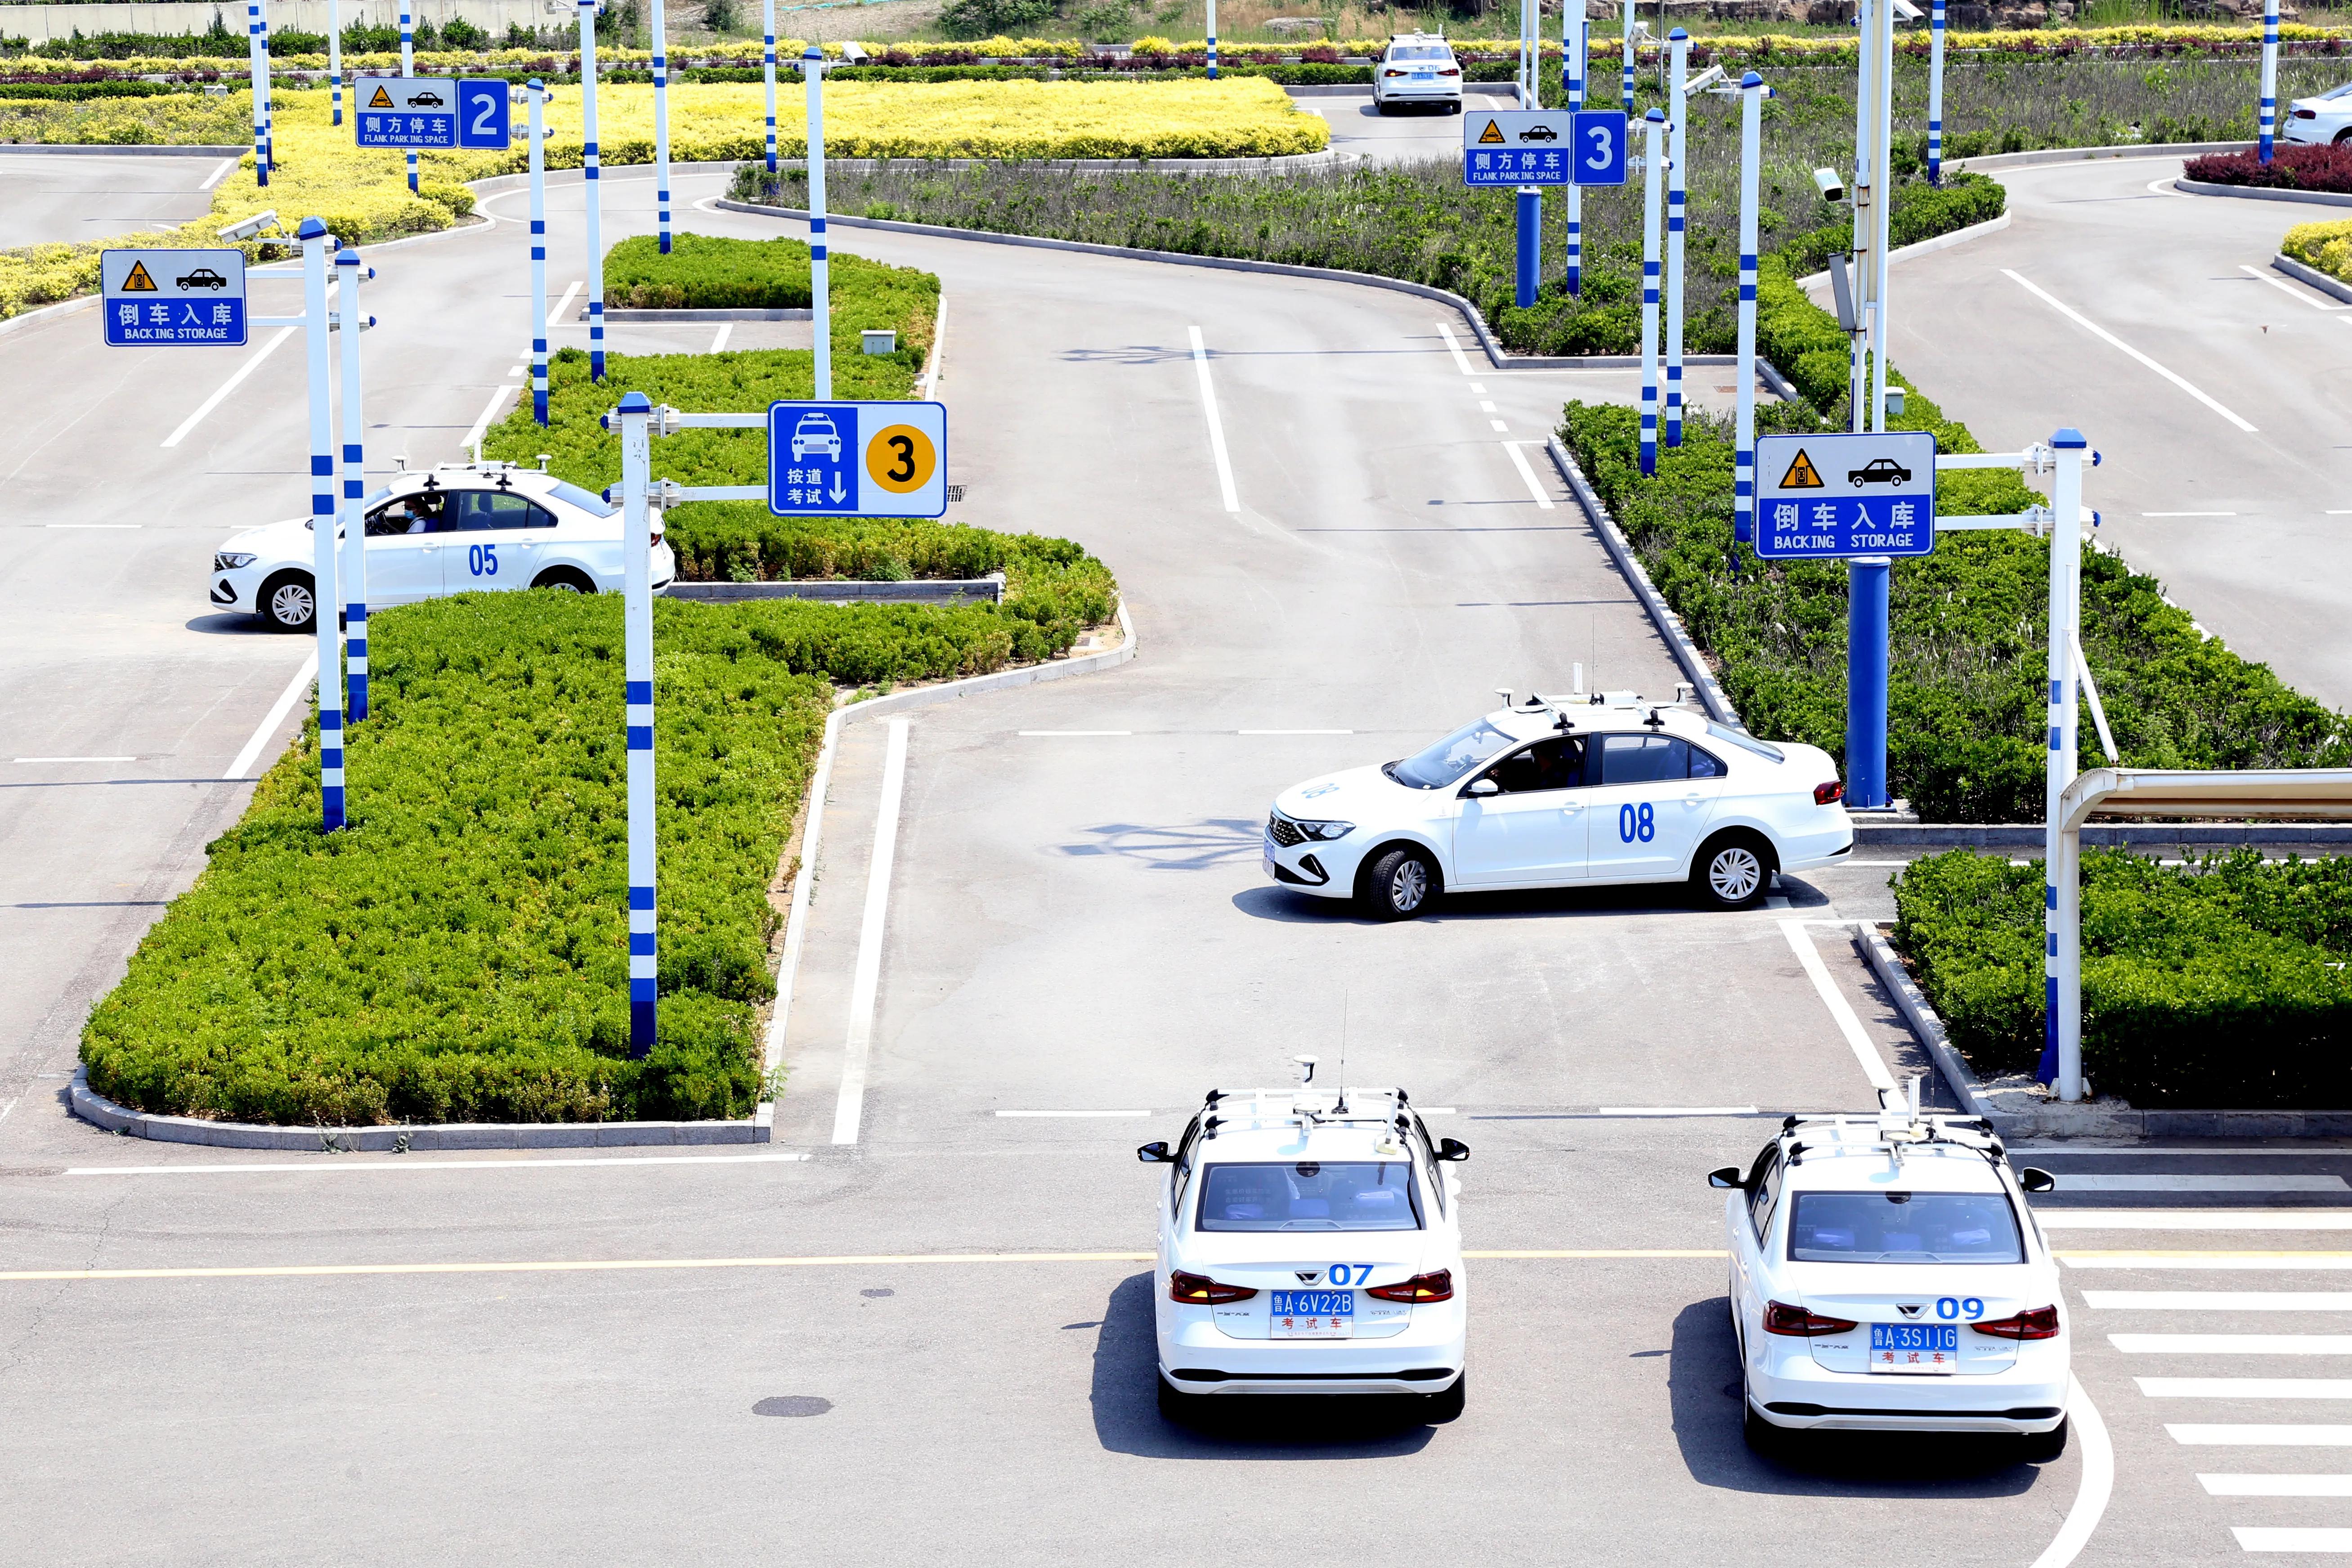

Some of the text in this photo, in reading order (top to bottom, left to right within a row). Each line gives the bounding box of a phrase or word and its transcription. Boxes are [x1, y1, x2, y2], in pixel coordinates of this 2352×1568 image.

[471, 94, 497, 135] 2
[365, 116, 447, 134] 侧方停车
[364, 134, 448, 144] FLANK PARKING SPACE
[1586, 126, 1613, 170] 3
[1475, 152, 1560, 170] 侧方停车
[1473, 171, 1561, 180] FLANK PARKING SPACE
[118, 303, 232, 326] 倒车入库
[125, 328, 228, 340] BACKING STORAGE
[887, 435, 915, 482] 3
[787, 468, 822, 485] 按道
[787, 488, 822, 505] 考试
[1773, 501, 1915, 532] 倒车入库
[1774, 533, 1913, 549] BACKING STORAGE
[469, 544, 498, 576] 05
[1301, 783, 1340, 798] 08
[1620, 802, 1654, 843] 08
[1329, 1264, 1374, 1286] 07
[1936, 1297, 1984, 1320] 09
[1282, 1317, 1342, 1330] 考试车
[1882, 1351, 1945, 1364] 考试车
